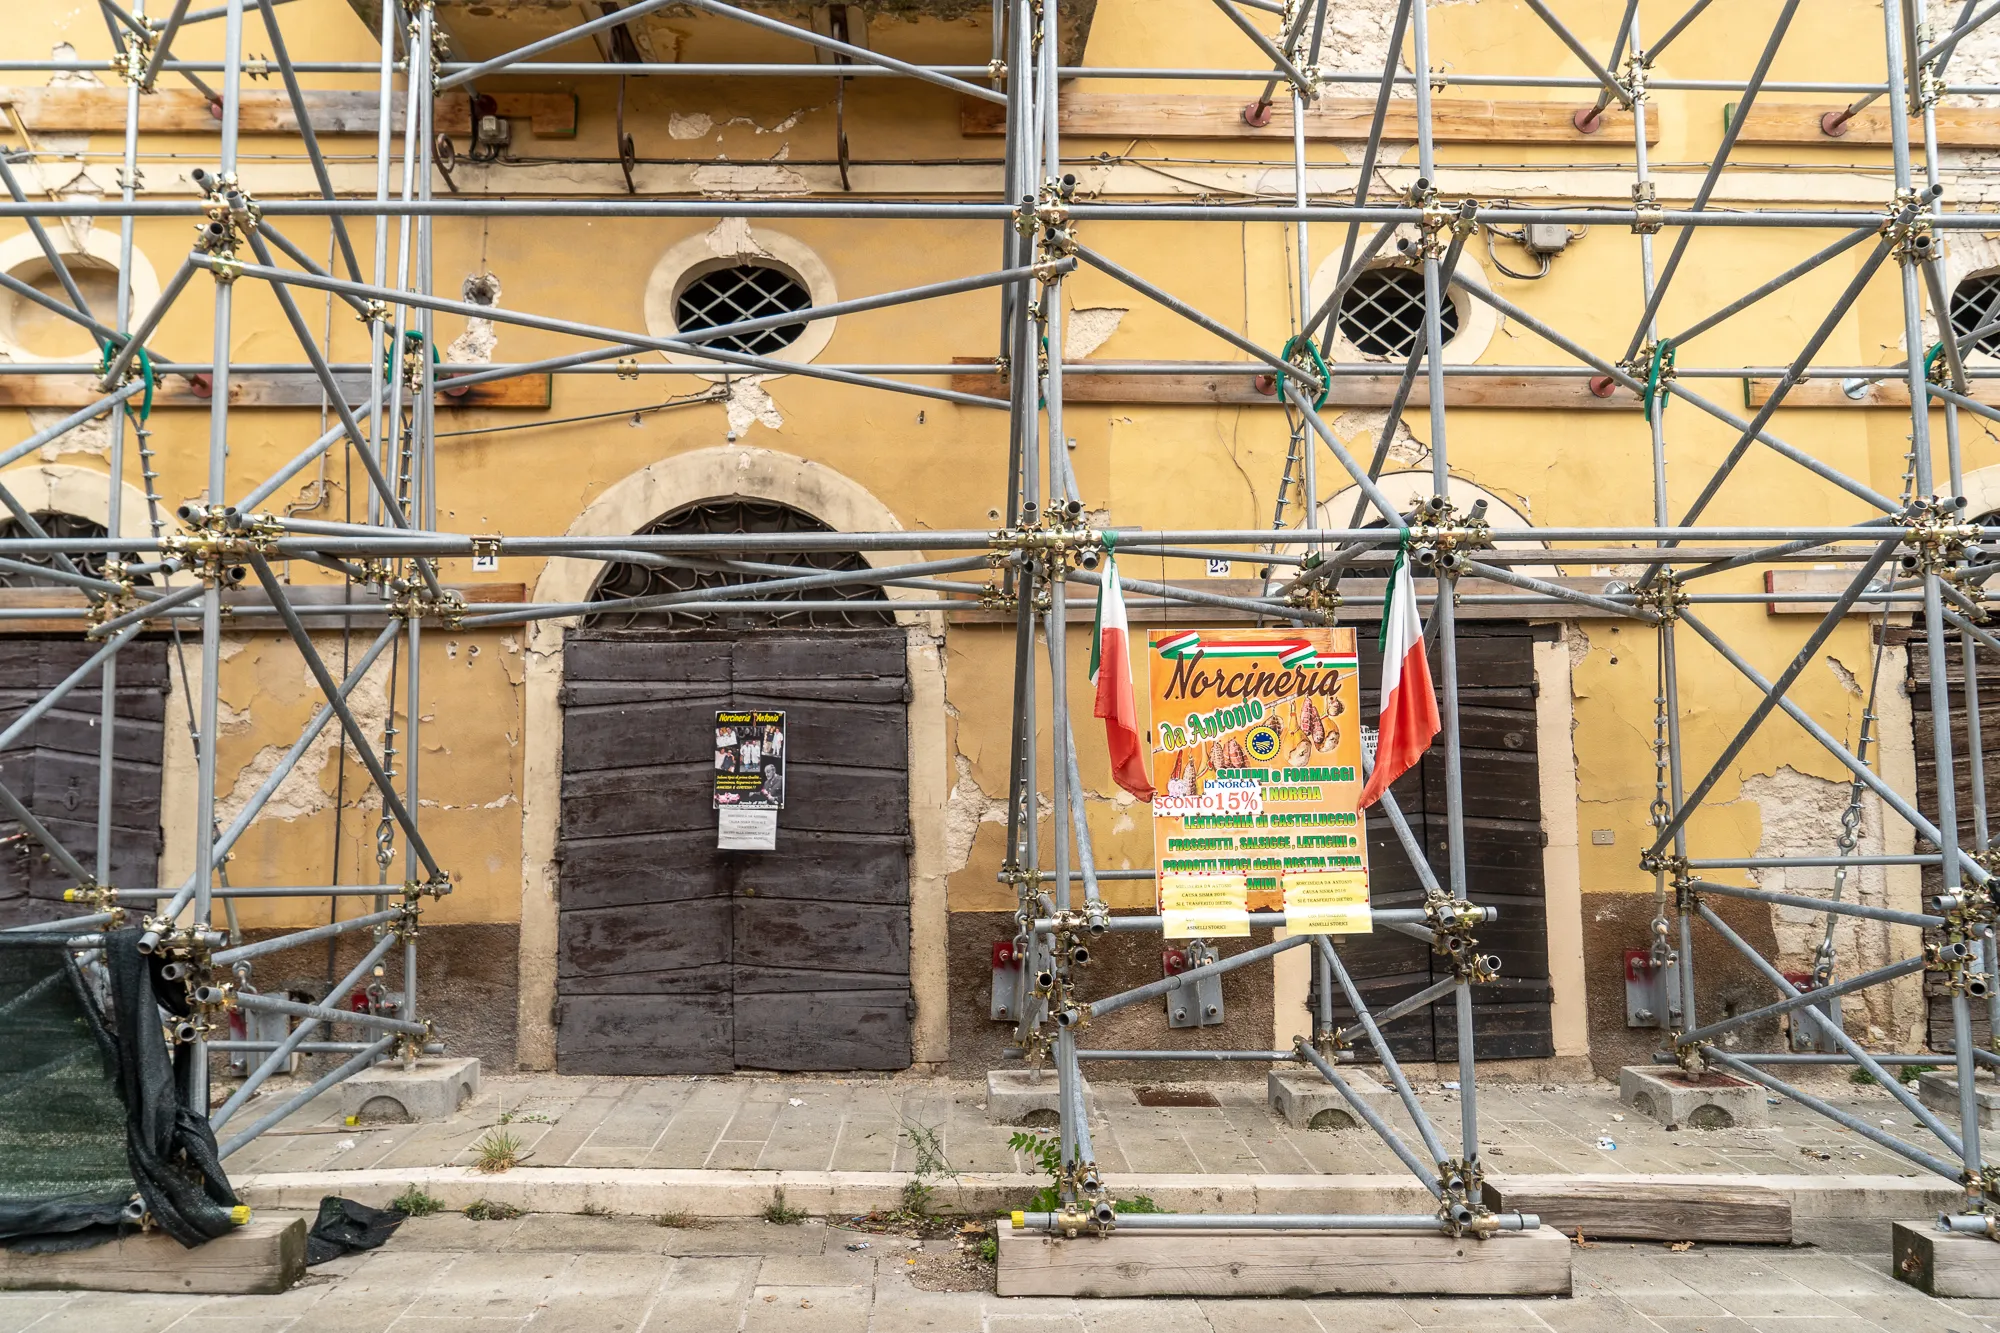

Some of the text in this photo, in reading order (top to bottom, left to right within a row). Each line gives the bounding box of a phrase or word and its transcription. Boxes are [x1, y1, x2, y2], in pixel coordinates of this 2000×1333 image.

[1209, 558, 1229, 573] 23
[1163, 649, 1342, 699] Norcineria
[718, 713, 751, 722] Norcineria
[1160, 697, 1263, 751] da Antonio
[1217, 767, 1355, 783] SALUMI e FORMAGGI
[1204, 780, 1256, 789] DI NORCIA
[1154, 790, 1258, 811] SCONTO 15%
[1269, 786, 1322, 801] NORCIA
[1184, 813, 1357, 829] LENTICCHIA di CASTELLUCCIO
[1296, 834, 1348, 849] LATTICINI
[1349, 836, 1357, 848] e
[1163, 855, 1362, 872] PRODOTTI TIPICI della NOSTRA TERRA
[1246, 877, 1277, 891] ANINI
